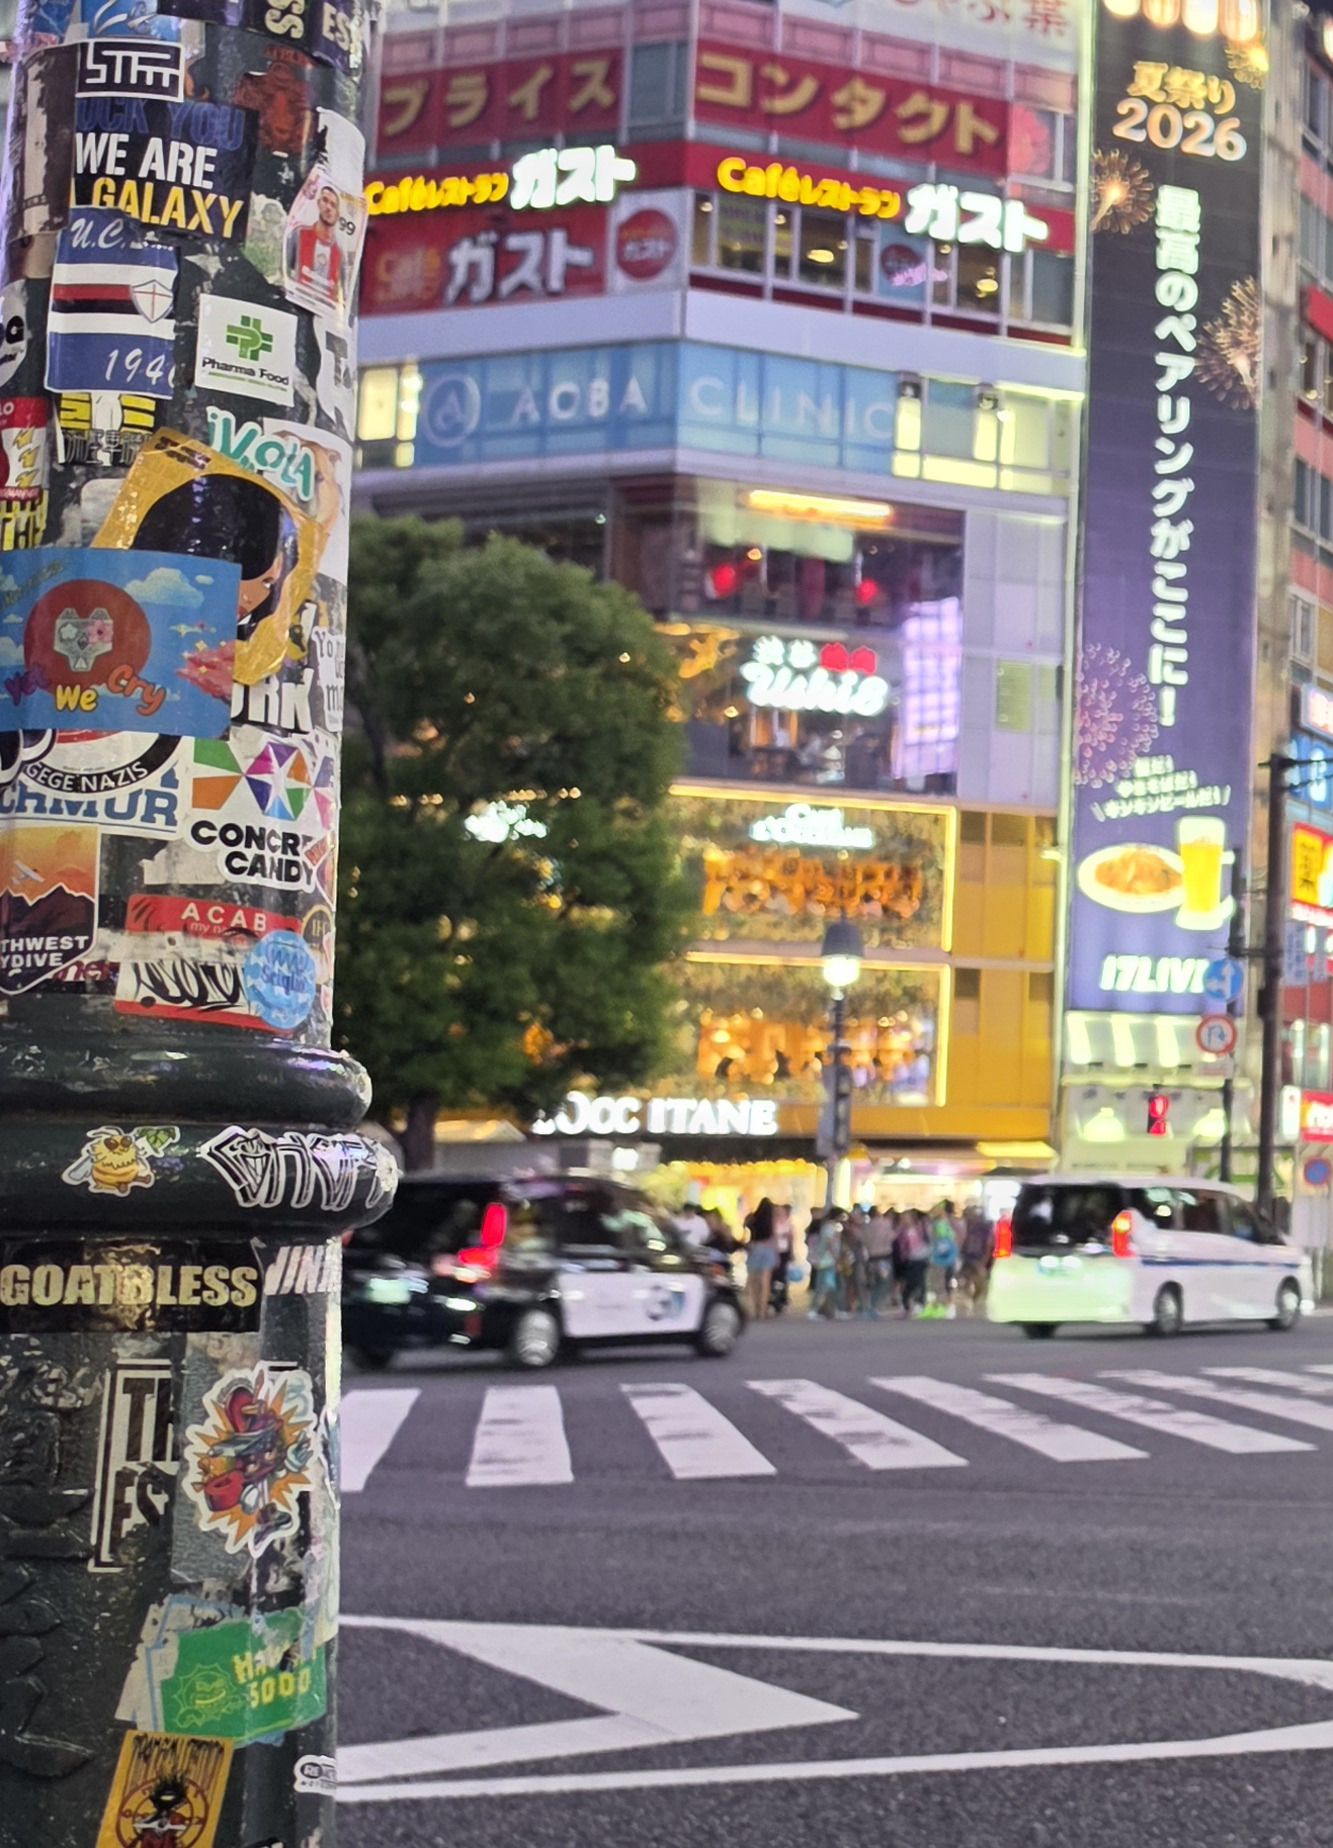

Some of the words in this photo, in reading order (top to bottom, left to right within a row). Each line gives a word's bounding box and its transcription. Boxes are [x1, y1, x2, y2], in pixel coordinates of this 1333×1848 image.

[384, 50, 615, 135] プライス
[697, 50, 999, 156] コンタクト
[75, 131, 128, 175] WE
[138, 138, 218, 190] ARE
[1112, 97, 1247, 161] 2026
[92, 178, 243, 239] GALAXY
[511, 145, 637, 209] ガスト
[904, 183, 1050, 252] ガスト
[446, 228, 593, 303] ガスト
[202, 356, 256, 377] Pharma
[259, 367, 289, 387] Food
[690, 375, 893, 440] CLINIC
[56, 684, 98, 711] We
[107, 664, 166, 716] Cry
[81, 761, 148, 792] NAZIS
[225, 851, 314, 886] CANDY
